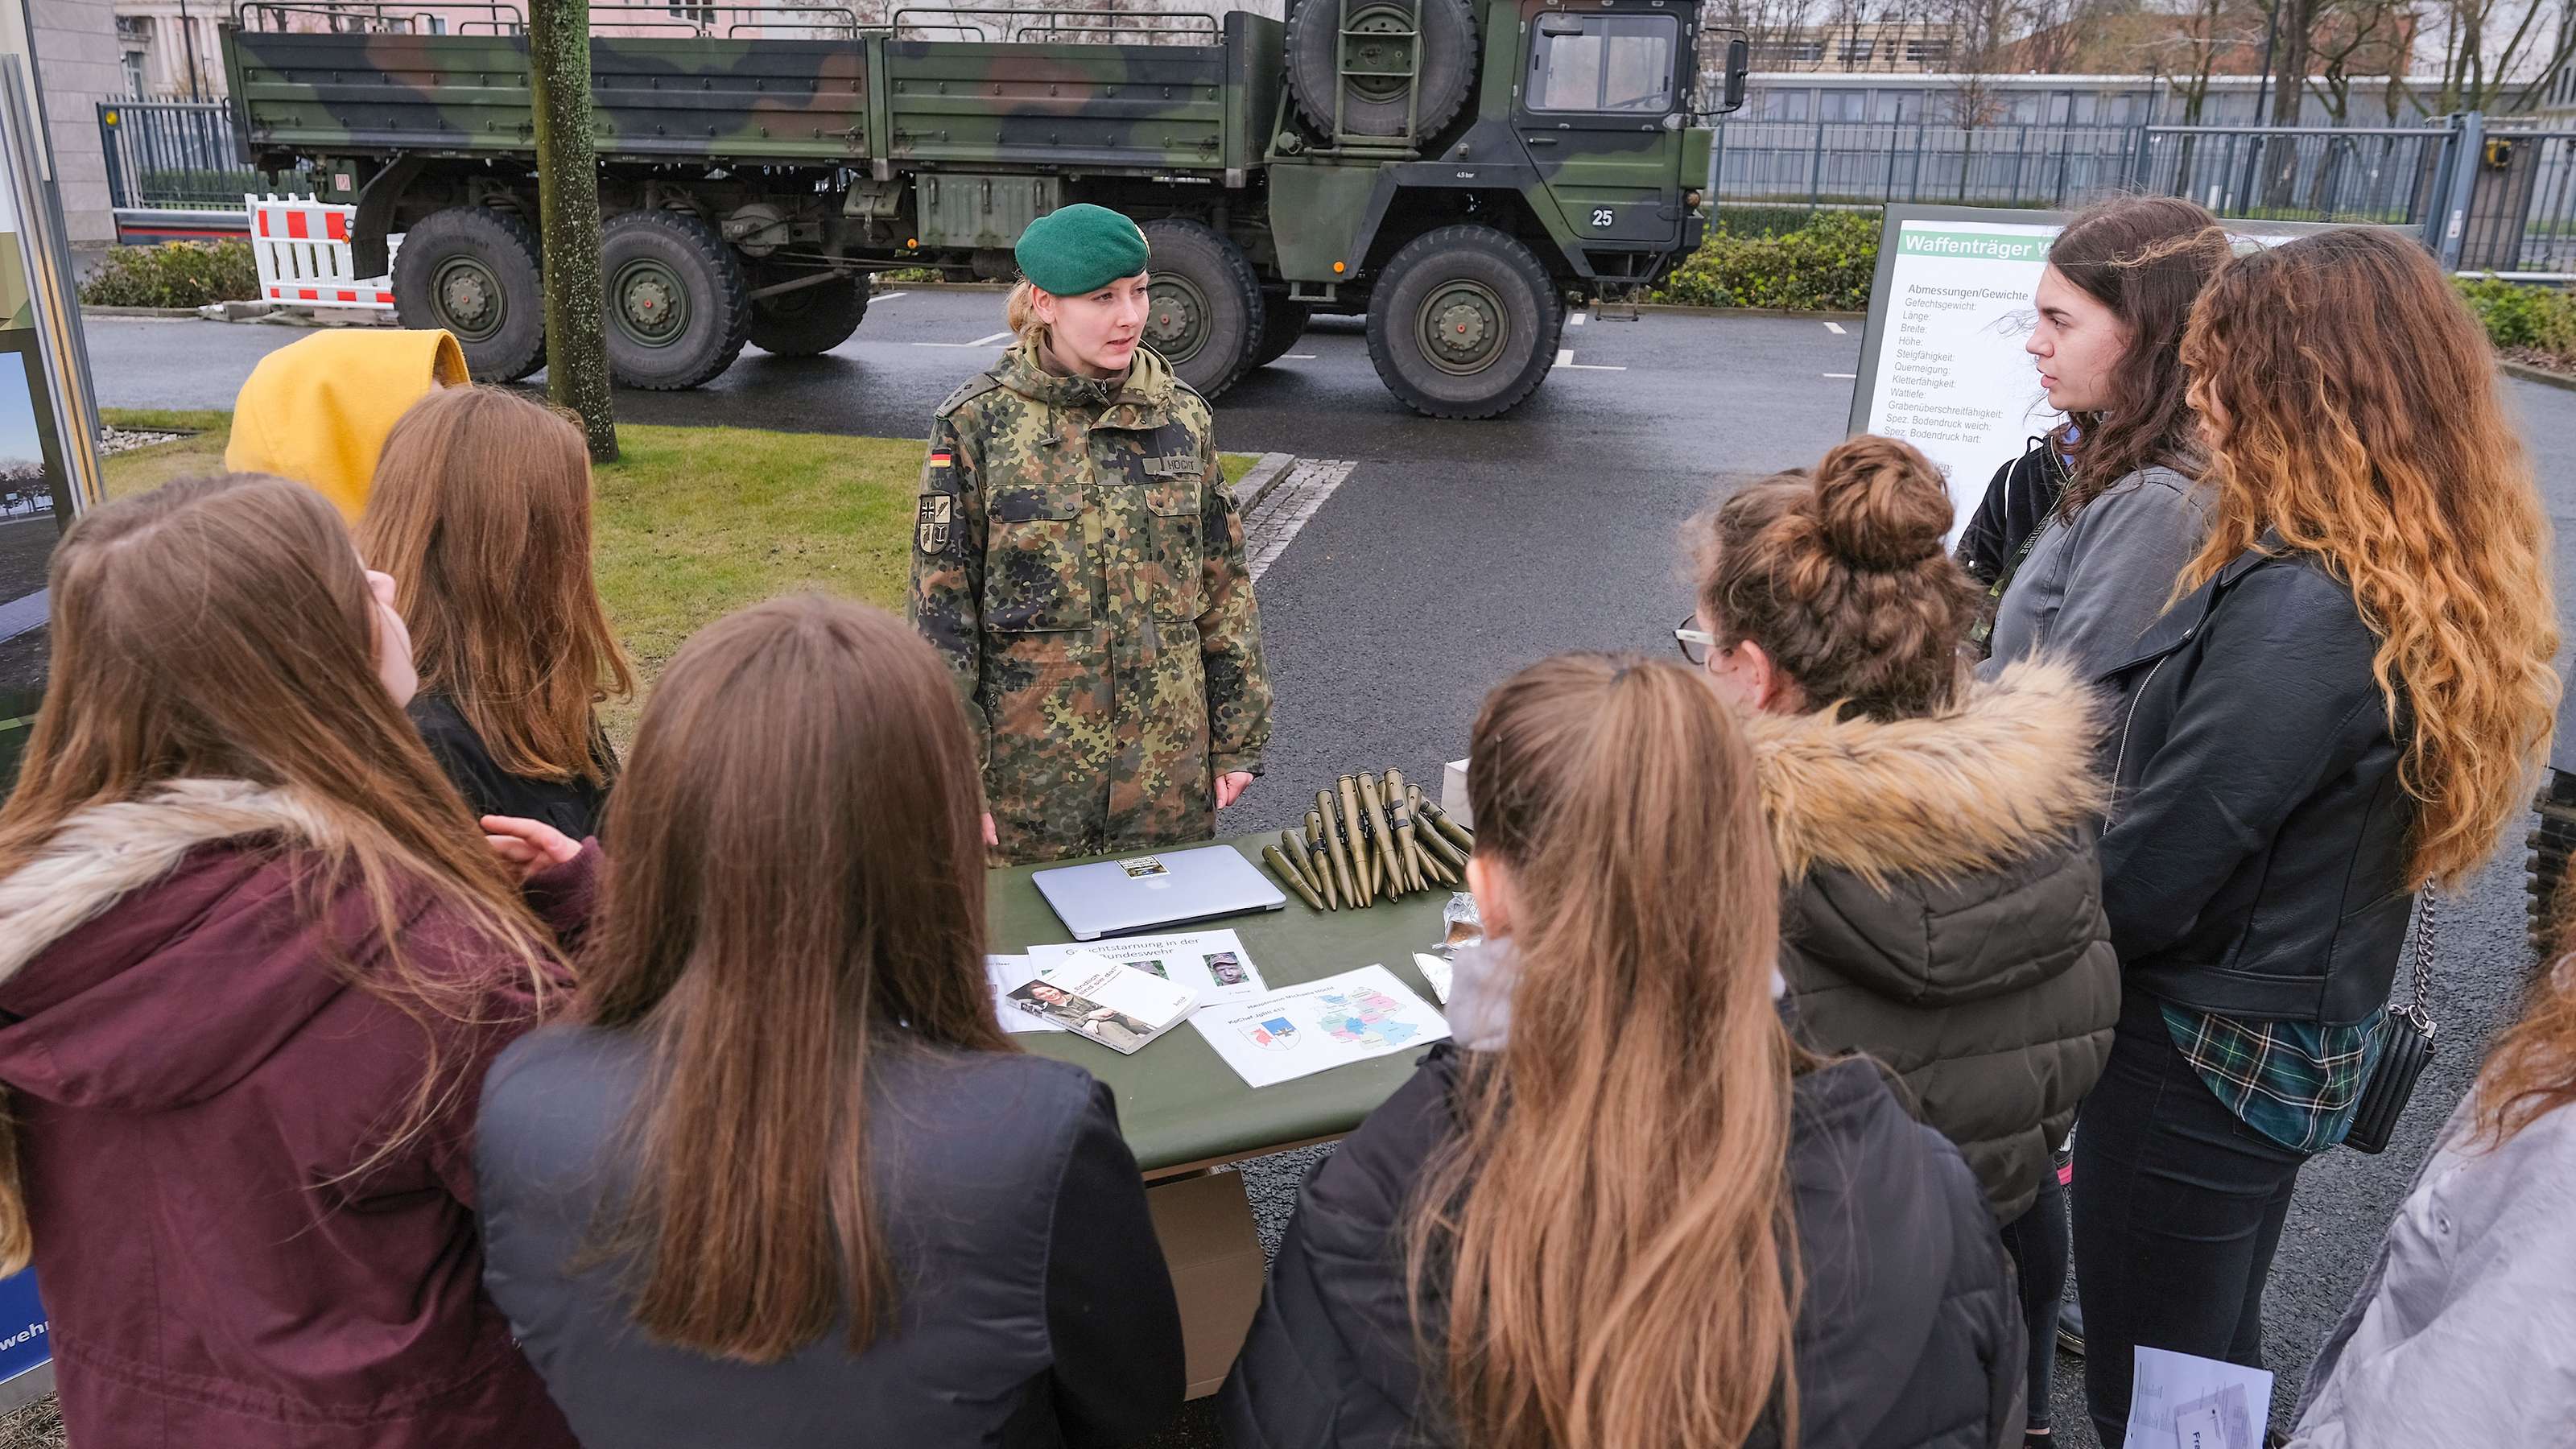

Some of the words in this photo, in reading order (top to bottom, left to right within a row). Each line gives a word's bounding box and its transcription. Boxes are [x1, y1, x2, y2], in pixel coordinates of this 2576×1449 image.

[1592, 209, 1612, 226] 25
[1905, 234, 2032, 259] Waffenträger
[1908, 284, 2029, 301] Abmessungen/Gewichte
[1905, 297, 1977, 311] Gefechtsgewicht:
[1902, 311, 1931, 323] Länge:
[1901, 324, 1927, 334] Breite:
[1898, 336, 1923, 346] Höhe:
[1897, 349, 1955, 362] Steigfähigkeit:
[1894, 361, 1951, 377] Querneigung:
[1893, 374, 1957, 389] Kletterfähigkeit:
[1890, 388, 1926, 399] Wattiefe:
[1888, 400, 2003, 419] Grabenüberschreitfähigkeit:
[1885, 413, 1909, 424] Spez.
[1912, 415, 1962, 428] Bodendruck
[1964, 422, 1992, 431] weich:
[1909, 428, 1960, 441] Bodendruck
[1962, 433, 1983, 444] hart:
[1065, 941, 1163, 956] Gichtstarnung
